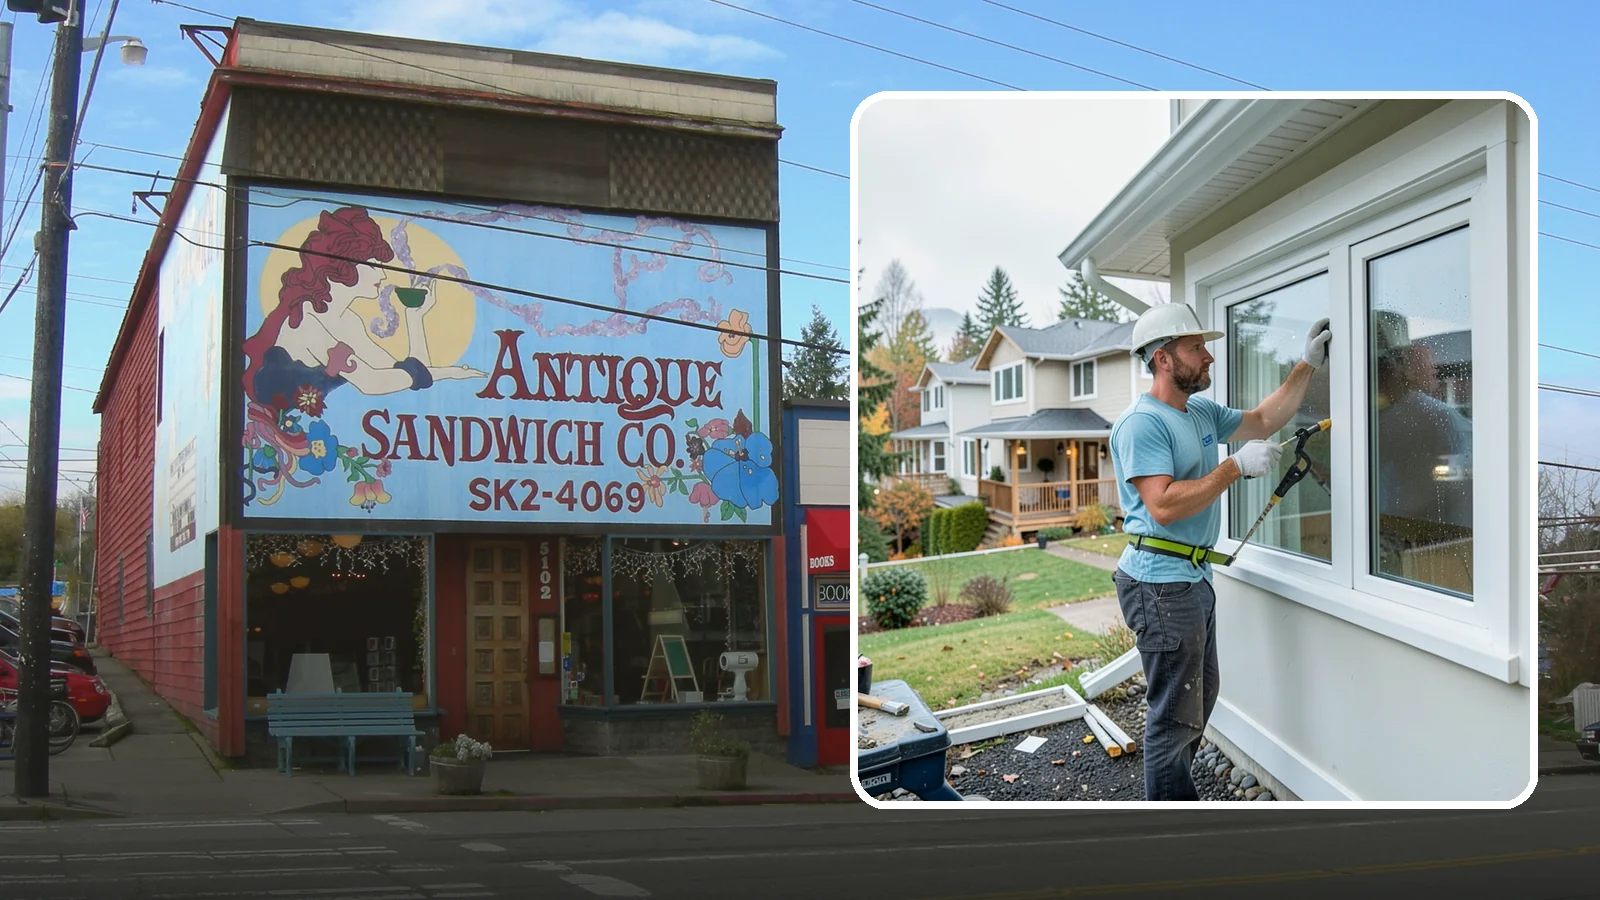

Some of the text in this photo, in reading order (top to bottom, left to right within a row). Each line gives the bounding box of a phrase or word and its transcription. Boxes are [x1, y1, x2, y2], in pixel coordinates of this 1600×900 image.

[475, 329, 724, 421] ANTIQUE
[361, 408, 685, 469] SANDWICH CO.
[468, 477, 646, 513] SK2-4069
[540, 541, 551, 600] 5102
[809, 555, 835, 569] BOOKS
